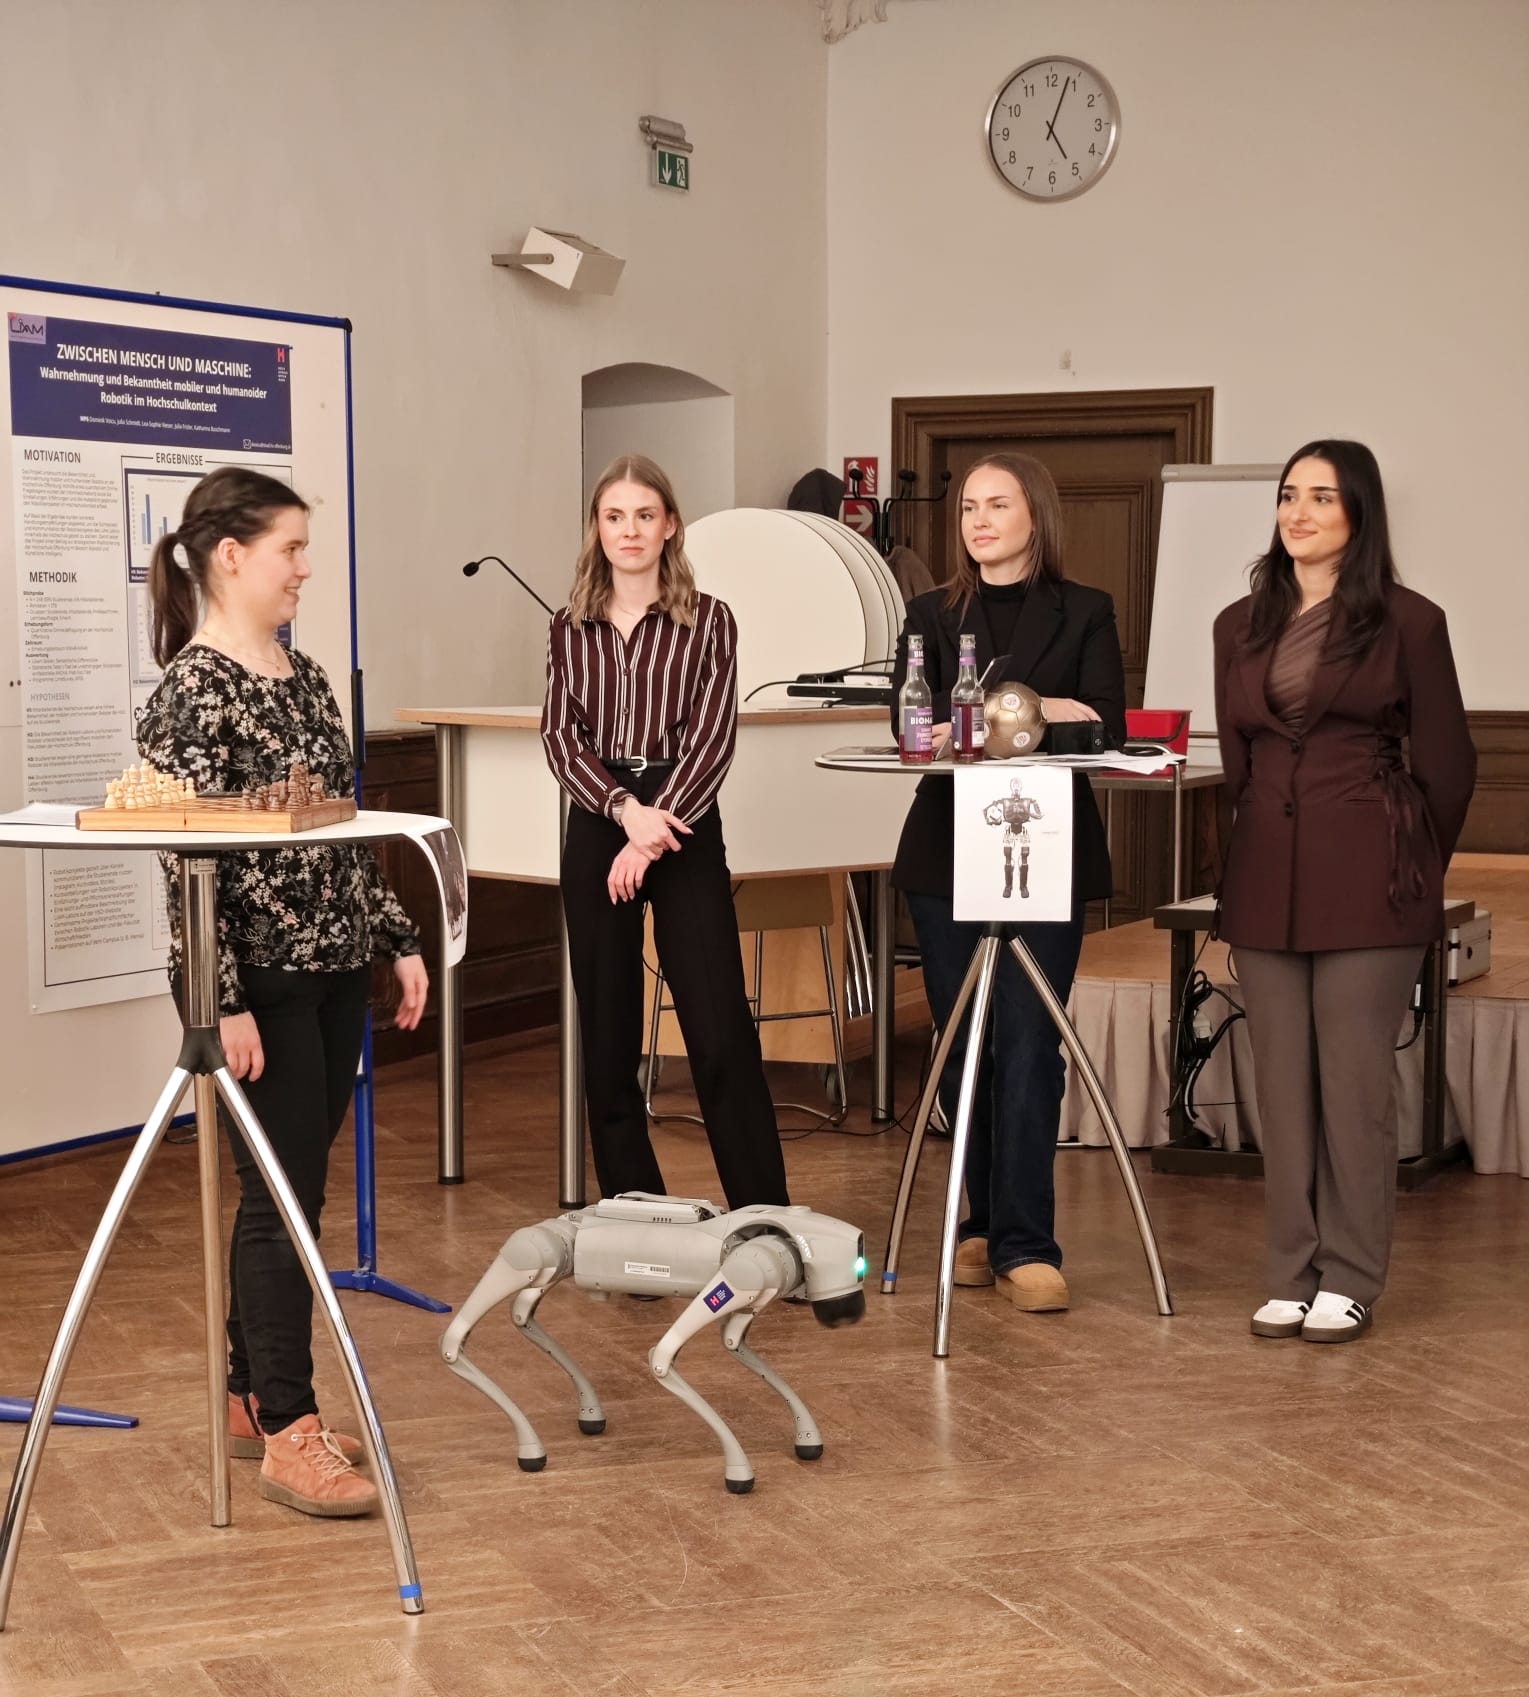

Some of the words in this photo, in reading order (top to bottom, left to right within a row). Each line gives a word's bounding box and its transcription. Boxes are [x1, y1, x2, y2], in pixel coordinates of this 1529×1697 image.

[1046, 74, 1058, 87] 12
[1072, 80, 1076, 92] 1
[1024, 84, 1034, 98] 11
[1088, 94, 1094, 107] 2
[1008, 104, 1021, 118] 10
[1094, 118, 1102, 132] 3
[1002, 128, 1010, 141] 9
[1088, 142, 1095, 156] 4
[1008, 150, 1016, 164] 8
[1026, 166, 1034, 180] 7
[1072, 162, 1079, 176] 5
[1048, 171, 1056, 184] 6
[56, 344, 118, 364] ZWISCHEN
[120, 350, 165, 370] MENSCH
[168, 356, 192, 372] UND
[195, 358, 252, 378] MASCHINE:
[277, 348, 285, 363] H
[40, 366, 104, 386] Wahrnehmung
[106, 374, 121, 385] und
[124, 375, 172, 390] Bekanntheit
[174, 381, 204, 393] mobiler
[206, 384, 221, 395] und
[222, 384, 268, 399] humanoider
[100, 392, 133, 406] Robotik
[134, 395, 144, 406] im
[146, 396, 217, 412] Hochschulkontext
[24, 449, 81, 463] MOTIVATION
[156, 453, 203, 466] ERGEBNISSE
[29, 572, 77, 583] METHODIK
[30, 692, 70, 702] HYPOTHESEN
